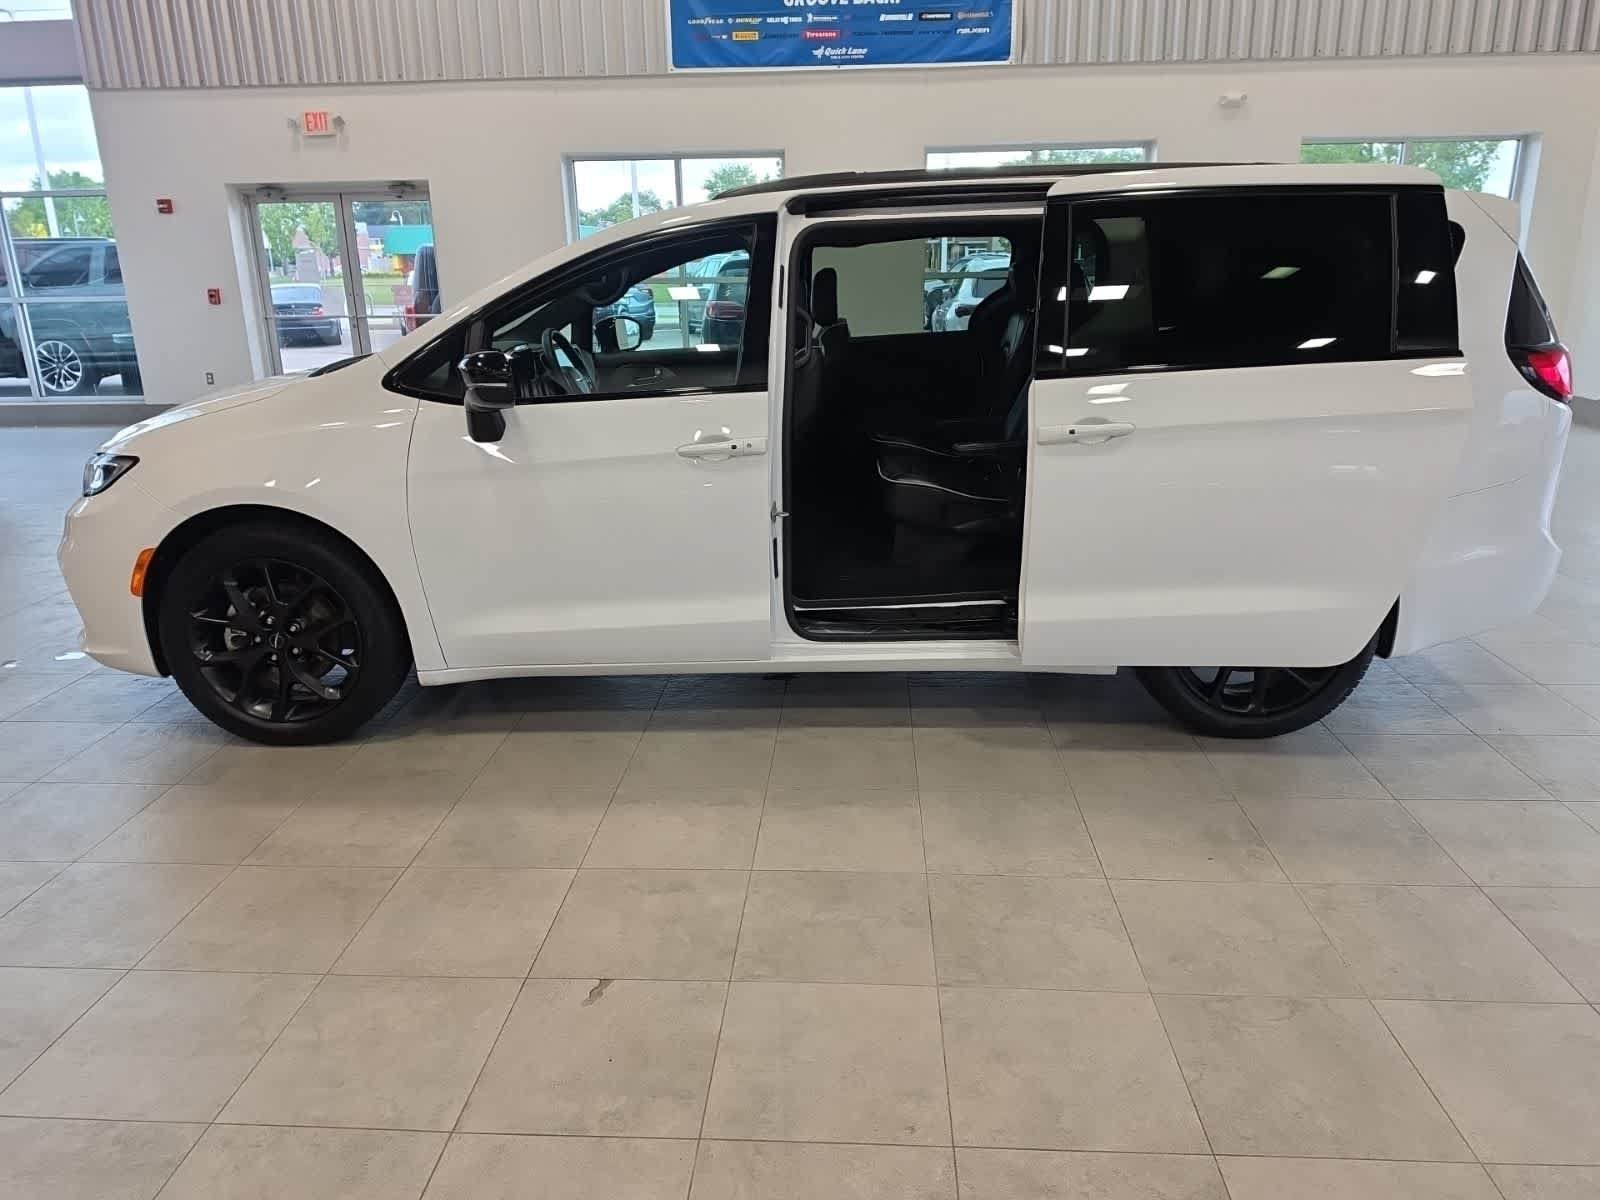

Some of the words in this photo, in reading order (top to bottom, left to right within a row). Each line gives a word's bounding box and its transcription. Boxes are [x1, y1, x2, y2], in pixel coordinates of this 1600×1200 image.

[824, 47, 847, 56] Quick
[847, 47, 868, 55] Lane
[304, 112, 329, 132] EXIT
